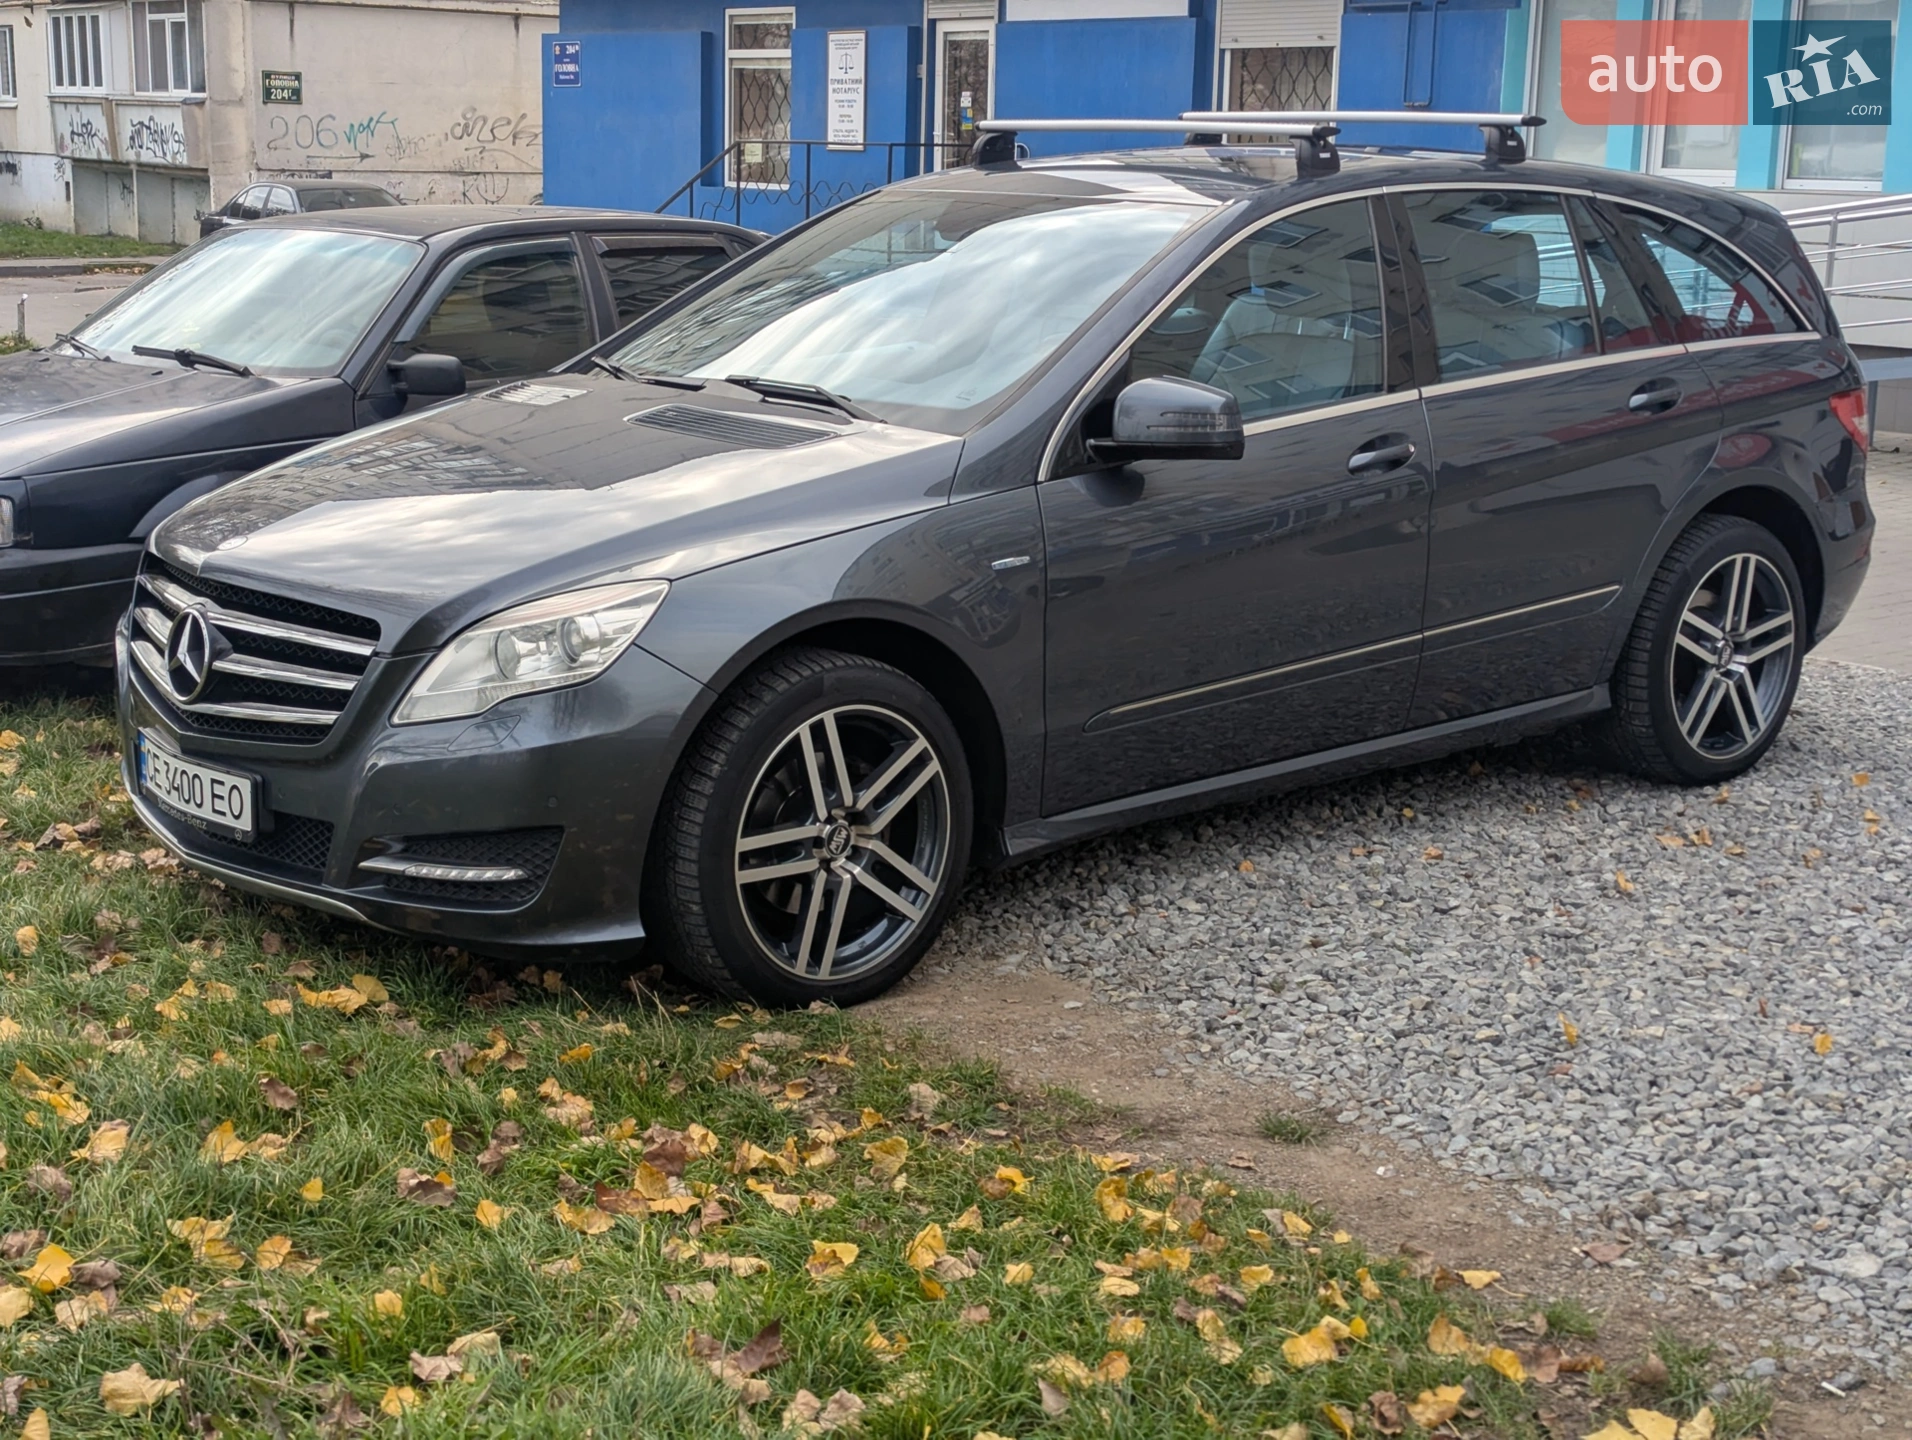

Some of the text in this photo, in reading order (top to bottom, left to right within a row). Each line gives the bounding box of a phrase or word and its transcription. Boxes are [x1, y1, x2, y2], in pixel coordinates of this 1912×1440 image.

[830, 77, 862, 85] ПРИВАТНИЙ
[266, 114, 339, 151] 206
[163, 759, 205, 810] 3400
[209, 776, 245, 821] EO
